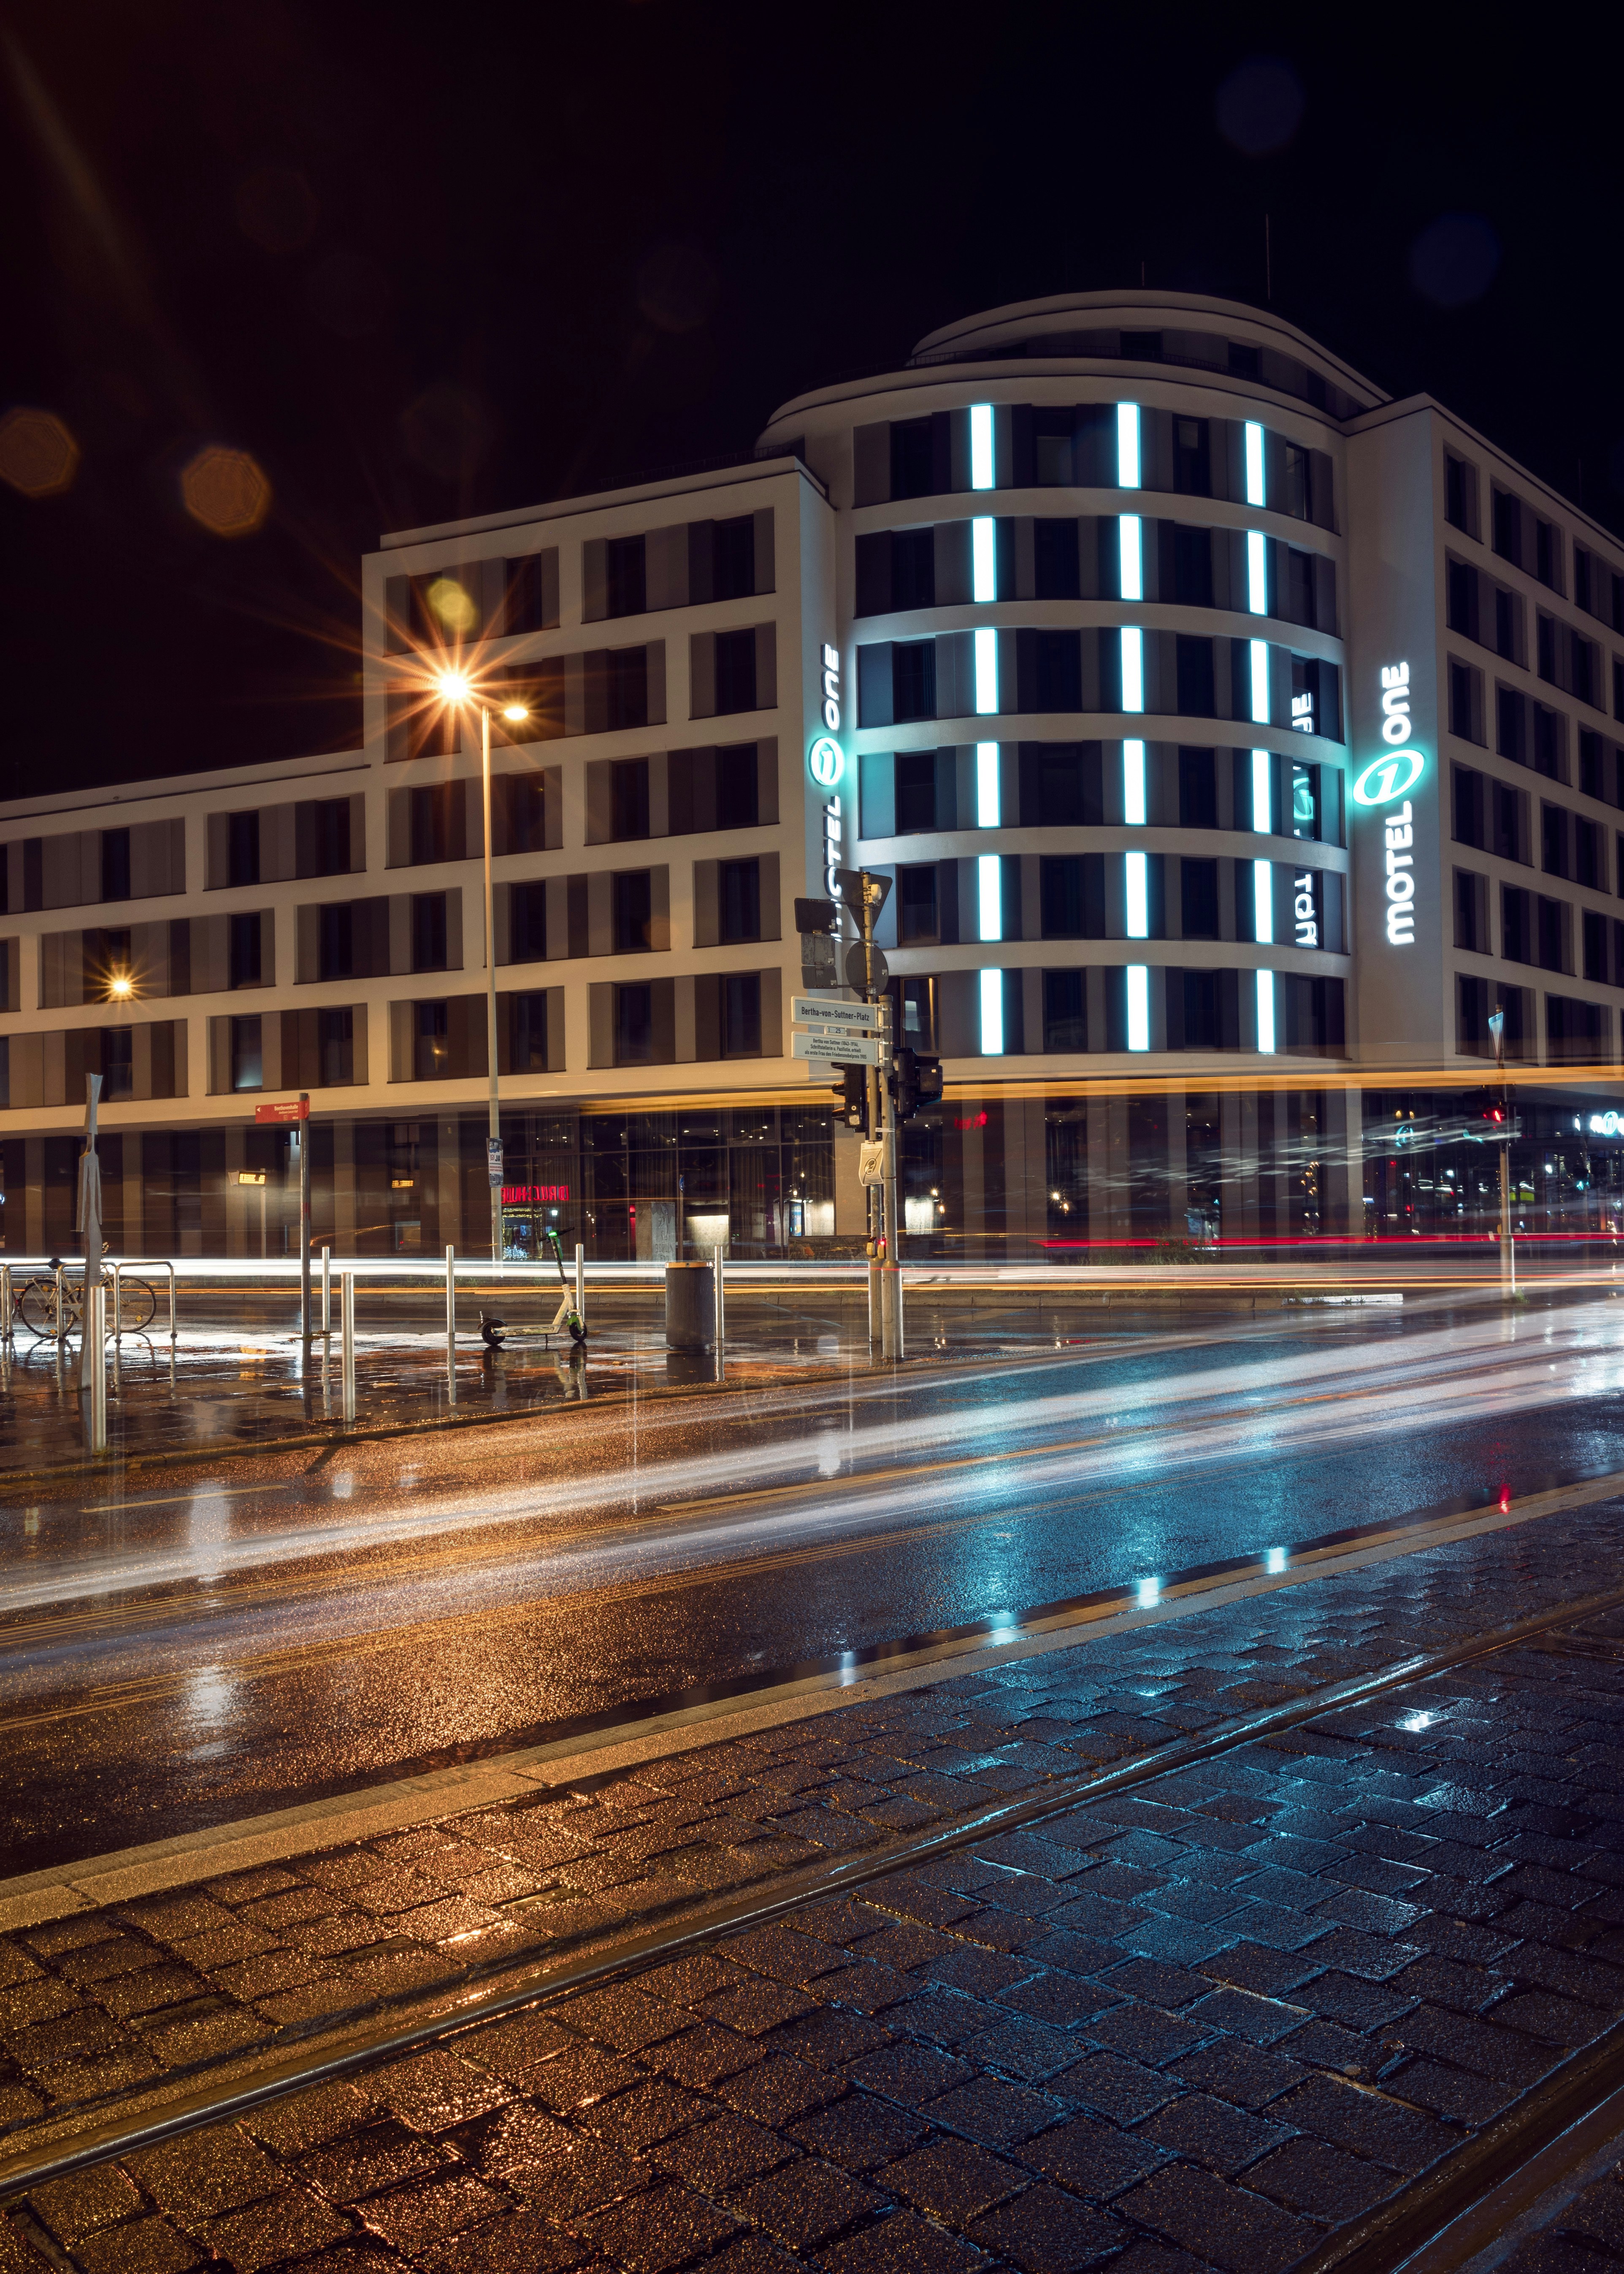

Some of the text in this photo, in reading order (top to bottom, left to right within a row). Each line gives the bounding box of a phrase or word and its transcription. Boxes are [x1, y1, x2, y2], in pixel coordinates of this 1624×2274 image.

[821, 644, 840, 731] ONE
[1381, 662, 1411, 745] ONE
[823, 795, 842, 942] OTEL
[1386, 800, 1415, 946] MOTEL
[801, 1006, 869, 1021] Bertha-von-Suttner-Platz
